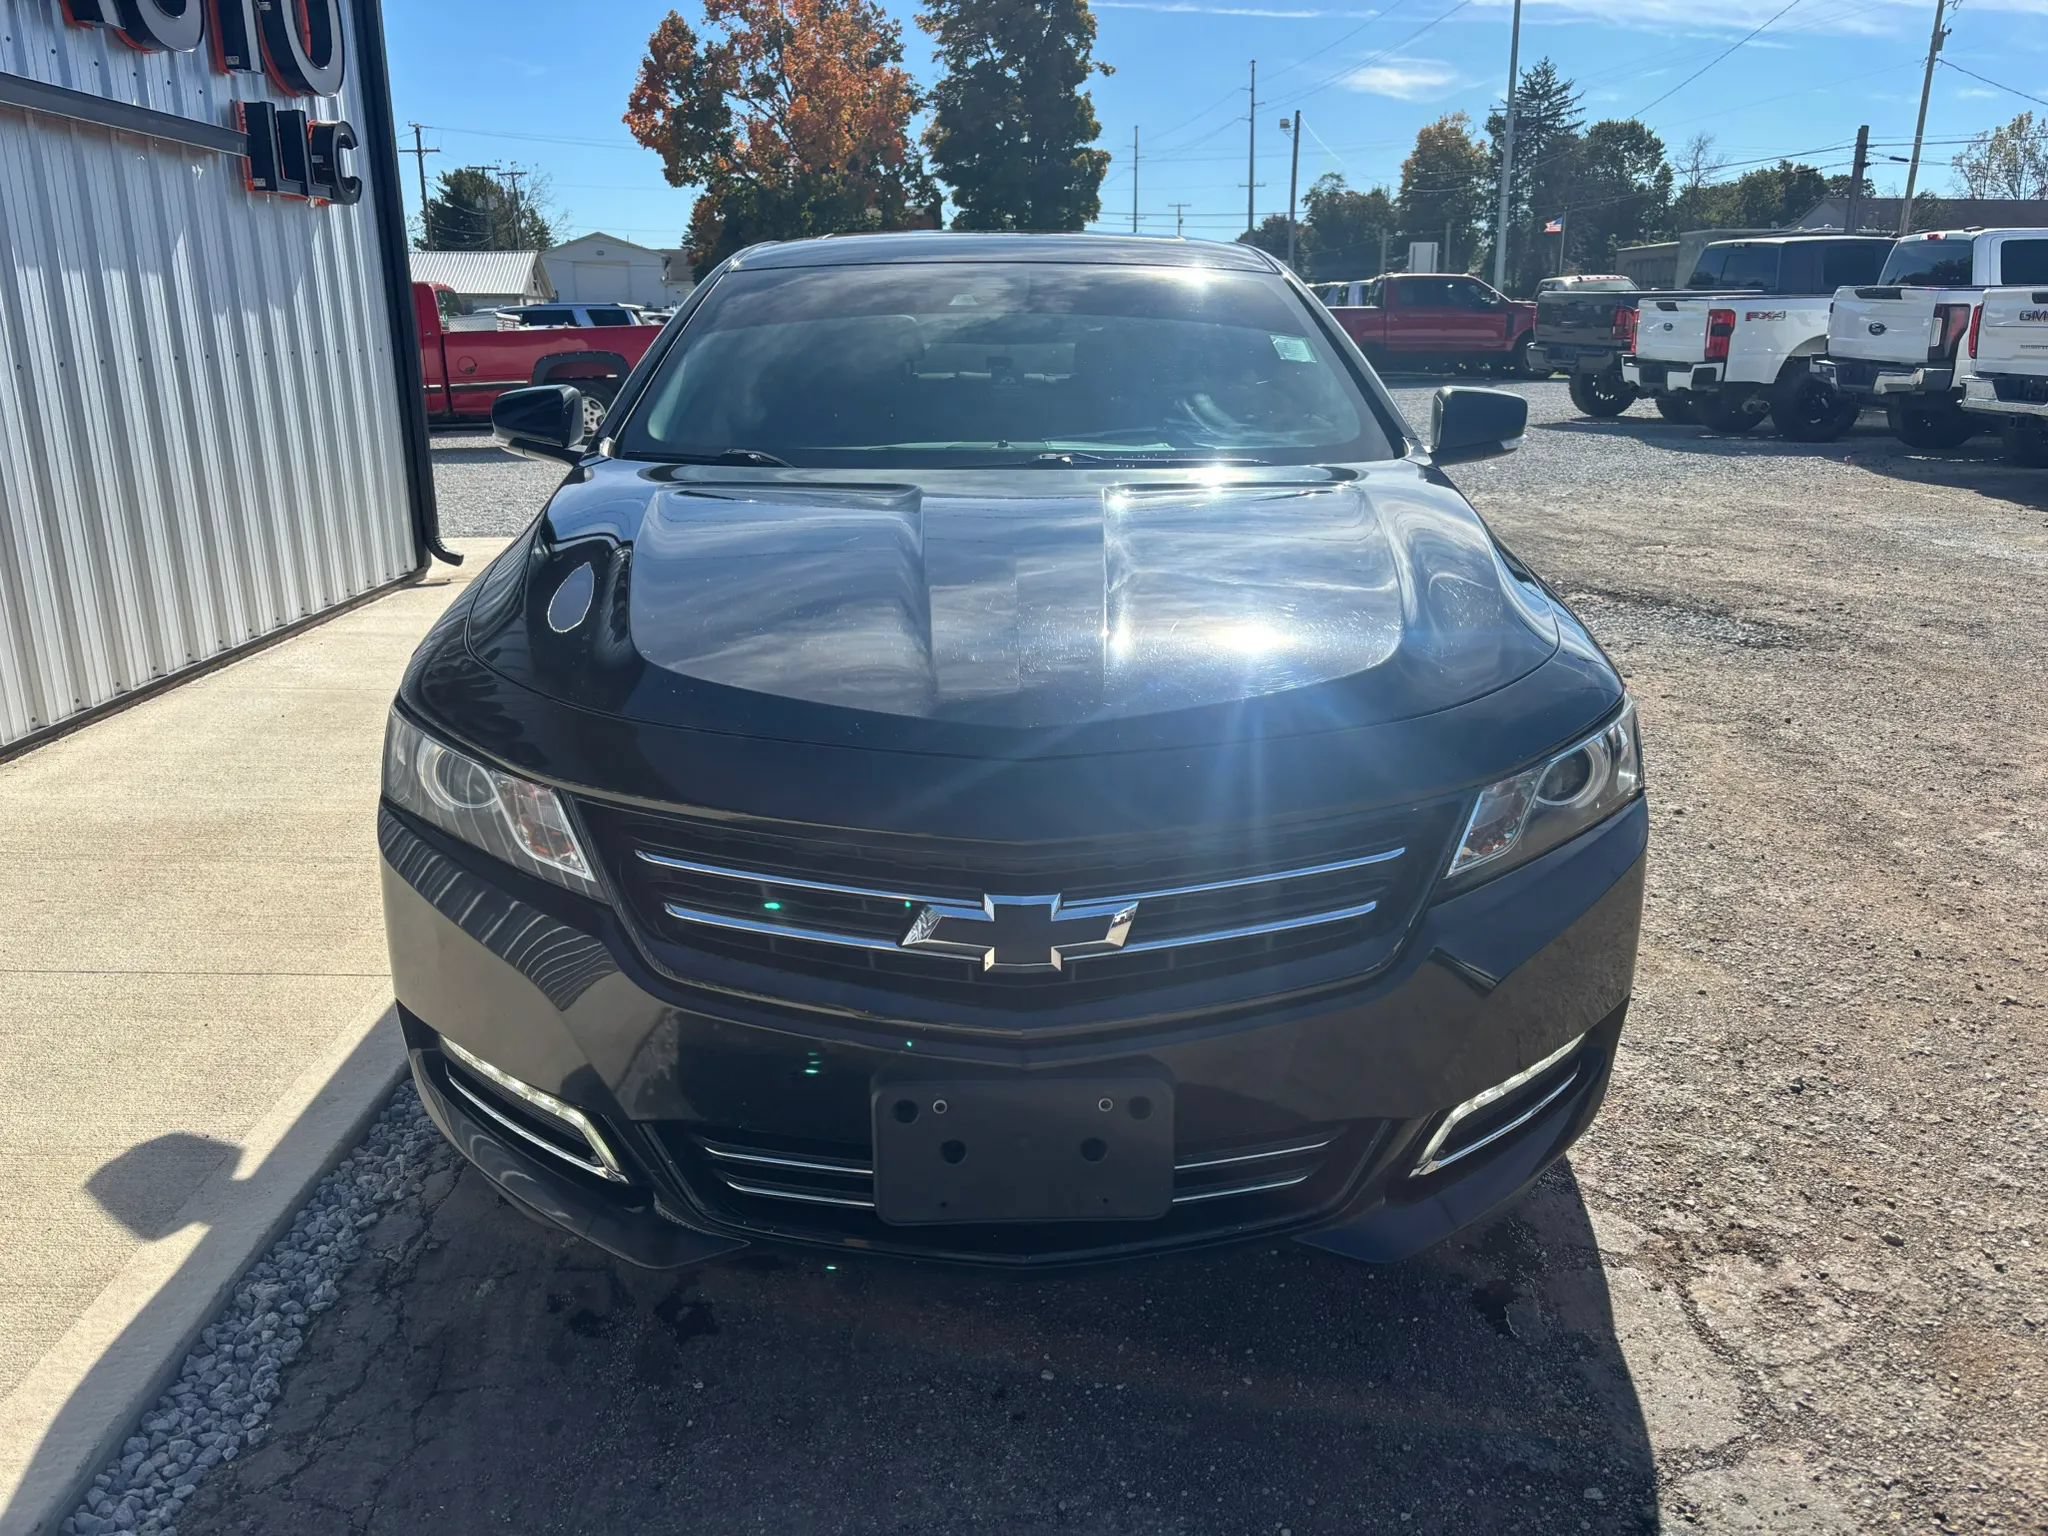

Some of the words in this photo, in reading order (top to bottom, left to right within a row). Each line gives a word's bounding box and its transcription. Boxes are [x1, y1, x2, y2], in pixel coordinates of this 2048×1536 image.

[244, 100, 363, 206] LLC
[1745, 310, 1787, 322] FX4
[2019, 310, 2048, 321] GM
